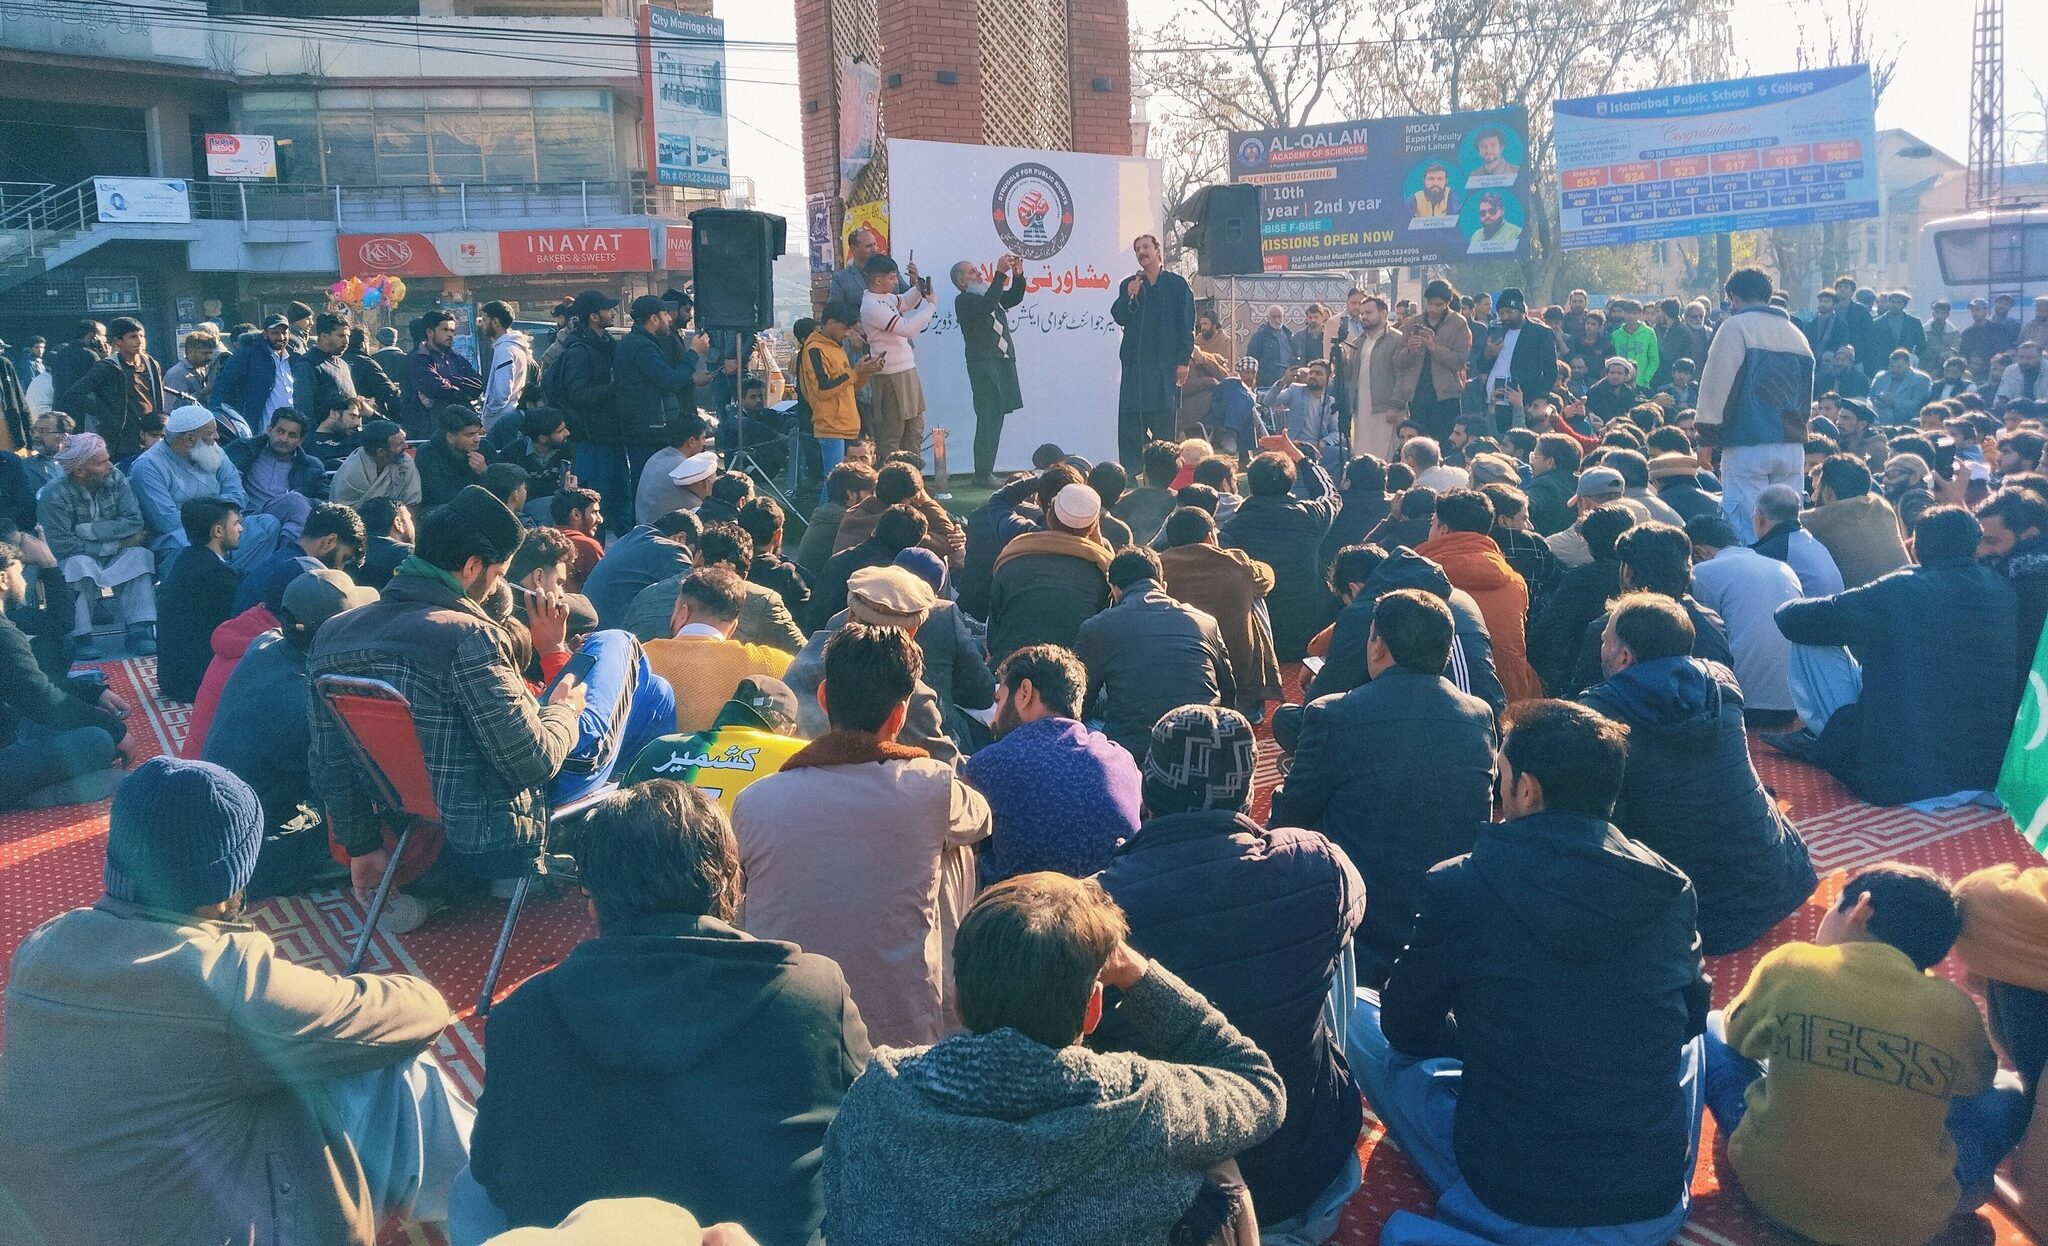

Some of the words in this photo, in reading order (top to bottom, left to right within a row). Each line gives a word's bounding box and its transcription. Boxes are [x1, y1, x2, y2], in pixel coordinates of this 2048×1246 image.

[652, 13, 668, 28] City
[670, 16, 706, 34] Marriage
[706, 24, 723, 37] Hall
[1610, 97, 1669, 113] Islamabad
[1673, 92, 1708, 106] Public
[1712, 87, 1749, 102] School
[1758, 84, 1767, 96] &
[1771, 82, 1814, 94] College
[1406, 123, 1440, 134] MDCAT
[1269, 128, 1368, 152] AL-QALAM
[1406, 135, 1430, 144] Expert
[1433, 133, 1462, 142] Faculty
[1272, 150, 1310, 162] ACADEMY
[1312, 149, 1322, 158] OF
[1325, 145, 1366, 156] SCIENCES
[1406, 144, 1426, 152] From
[1428, 142, 1456, 150] Lahore
[1646, 151, 1654, 160] TO
[1655, 150, 1666, 158] THE
[1716, 143, 1724, 152] OF
[1726, 142, 1736, 150] SSC
[1725, 160, 1746, 171] 517
[1776, 154, 1797, 166] 513
[660, 170, 670, 180] Ph
[1239, 174, 1282, 184] EVENING
[1285, 170, 1332, 180] COACHING
[1624, 171, 1645, 182] 524
[1675, 166, 1696, 176] 523
[997, 171, 1020, 202] STRUGGLE
[1020, 168, 1033, 176] FOR
[1033, 168, 1055, 183] PUBLIC
[1054, 180, 1069, 206] RIGHTS
[1576, 177, 1598, 188] 534
[1273, 186, 1304, 200] 10th
[1267, 206, 1299, 221] year
[1314, 198, 1342, 215] 2nd
[1348, 198, 1382, 214] year
[528, 234, 623, 252] INAYAT
[1262, 236, 1320, 251] MISSIONS
[1324, 232, 1358, 246] OPEN
[1362, 230, 1394, 243] NOW
[536, 254, 571, 264] BAKERS
[572, 254, 580, 262] &
[582, 252, 616, 262] SWEETS
[1292, 262, 1306, 270] Main
[1365, 258, 1386, 266] bypass
[1403, 256, 1419, 264] gojra
[1302, 254, 1314, 262] Gah
[1026, 264, 1111, 294] مشاورتی
[1008, 303, 1040, 333] ایکشن
[1041, 311, 1068, 333] عوامی
[1066, 311, 1104, 331] جوائنٹ
[652, 744, 761, 774] کشمیر
